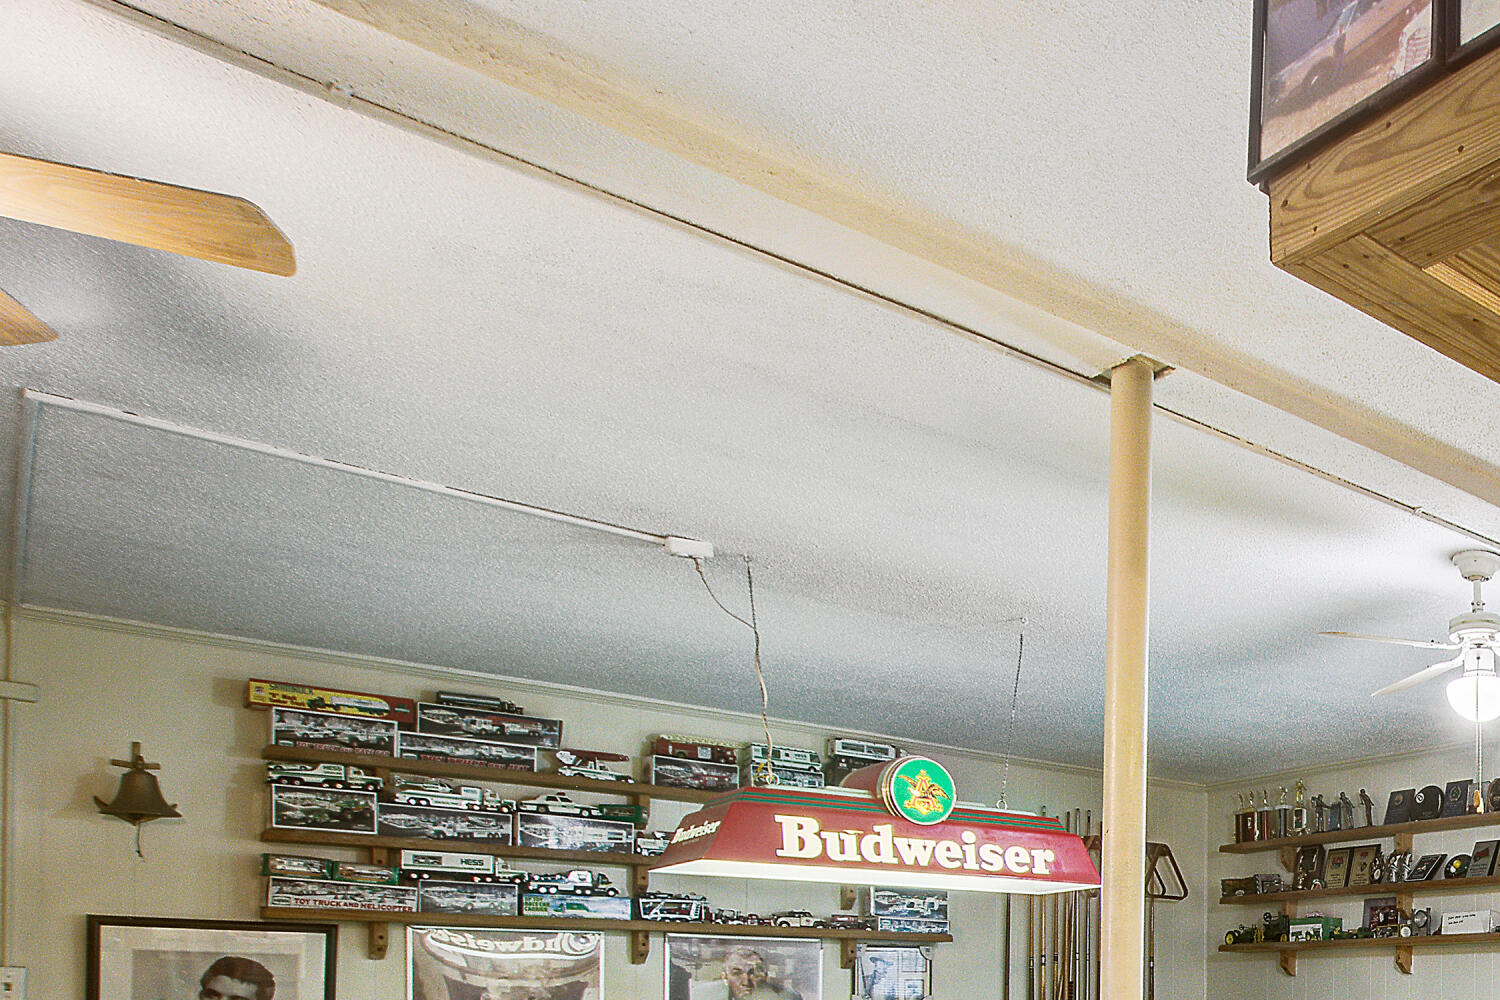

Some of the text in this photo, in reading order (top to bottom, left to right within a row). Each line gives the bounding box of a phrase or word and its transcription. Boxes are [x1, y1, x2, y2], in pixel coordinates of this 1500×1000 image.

[670, 819, 722, 845] Budweiser
[775, 814, 1055, 875] Budweiser
[460, 858, 485, 867] HESS
[294, 898, 312, 906] TOY
[313, 899, 341, 908] TRUCK
[360, 903, 414, 912] HELICOPTER
